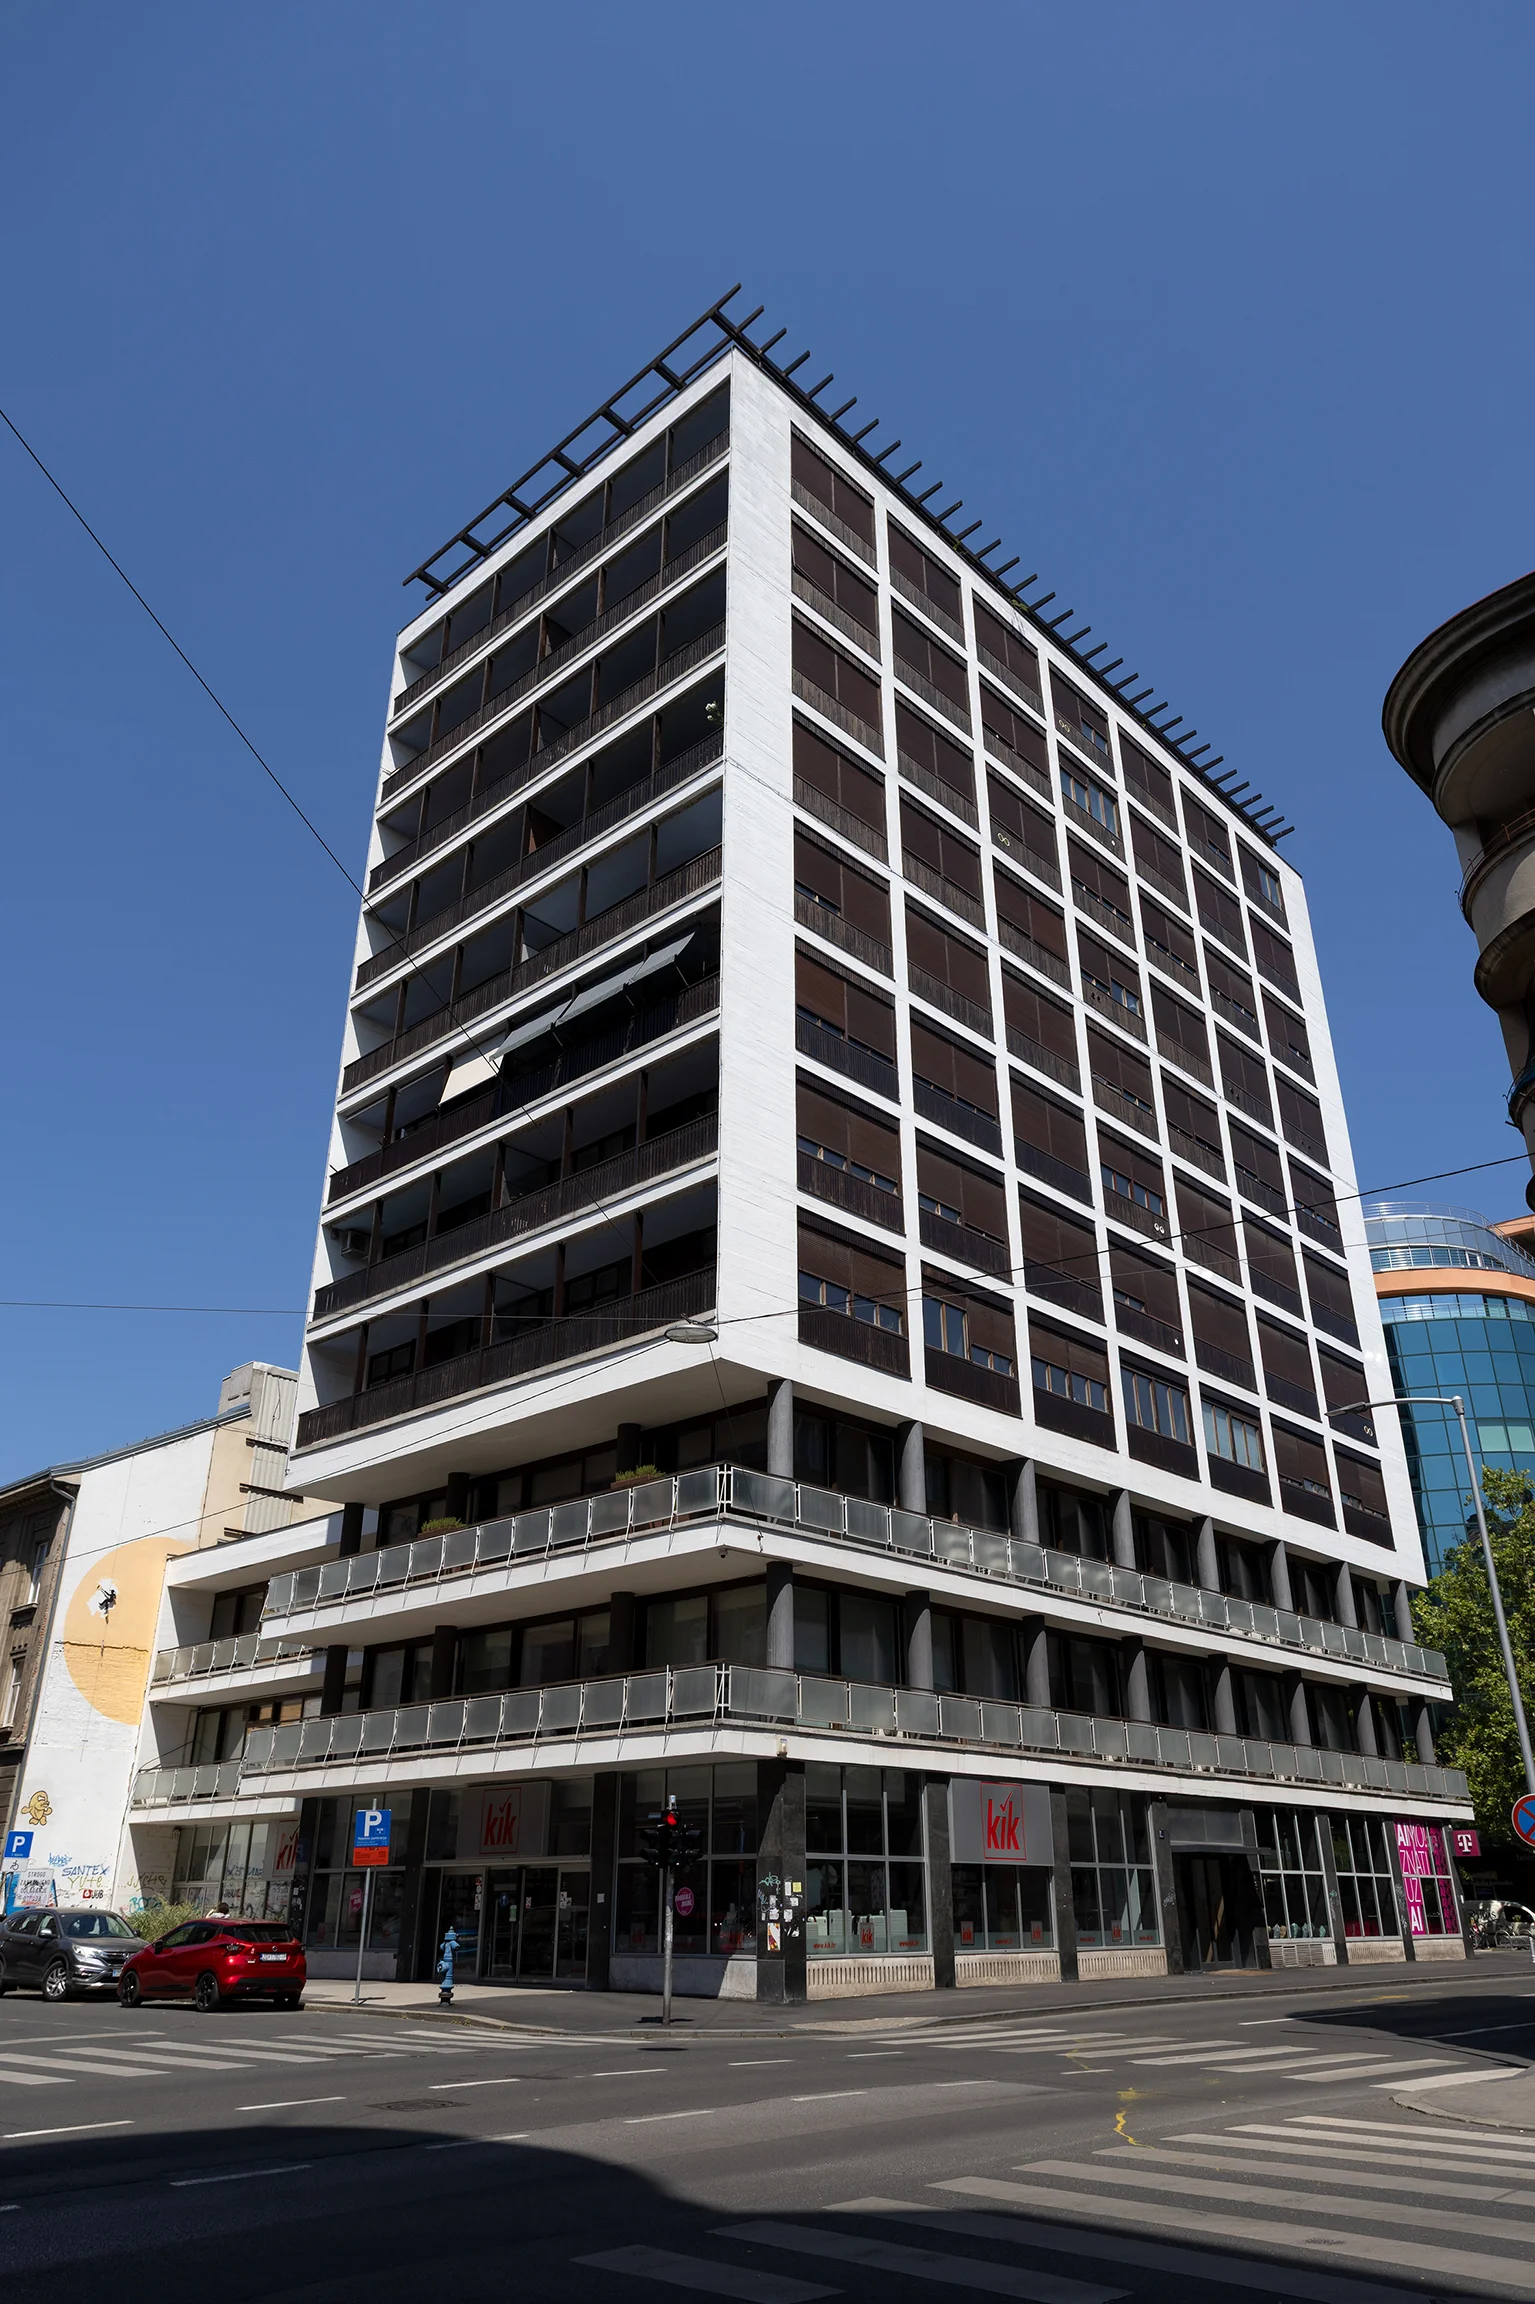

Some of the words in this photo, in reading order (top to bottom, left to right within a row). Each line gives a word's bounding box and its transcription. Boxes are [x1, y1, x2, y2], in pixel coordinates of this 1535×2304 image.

[364, 1811, 382, 1837] P
[483, 1794, 517, 1846] kik
[987, 1791, 1020, 1850] kik
[12, 1835, 26, 1853] P
[1457, 1834, 1473, 1853] T
[62, 1863, 110, 1877] SANTEX
[1400, 1849, 1431, 1875] ZNATI
[1403, 1877, 1422, 1903] UZ
[1411, 1906, 1424, 1932] AI
[861, 1926, 873, 1945] kik
